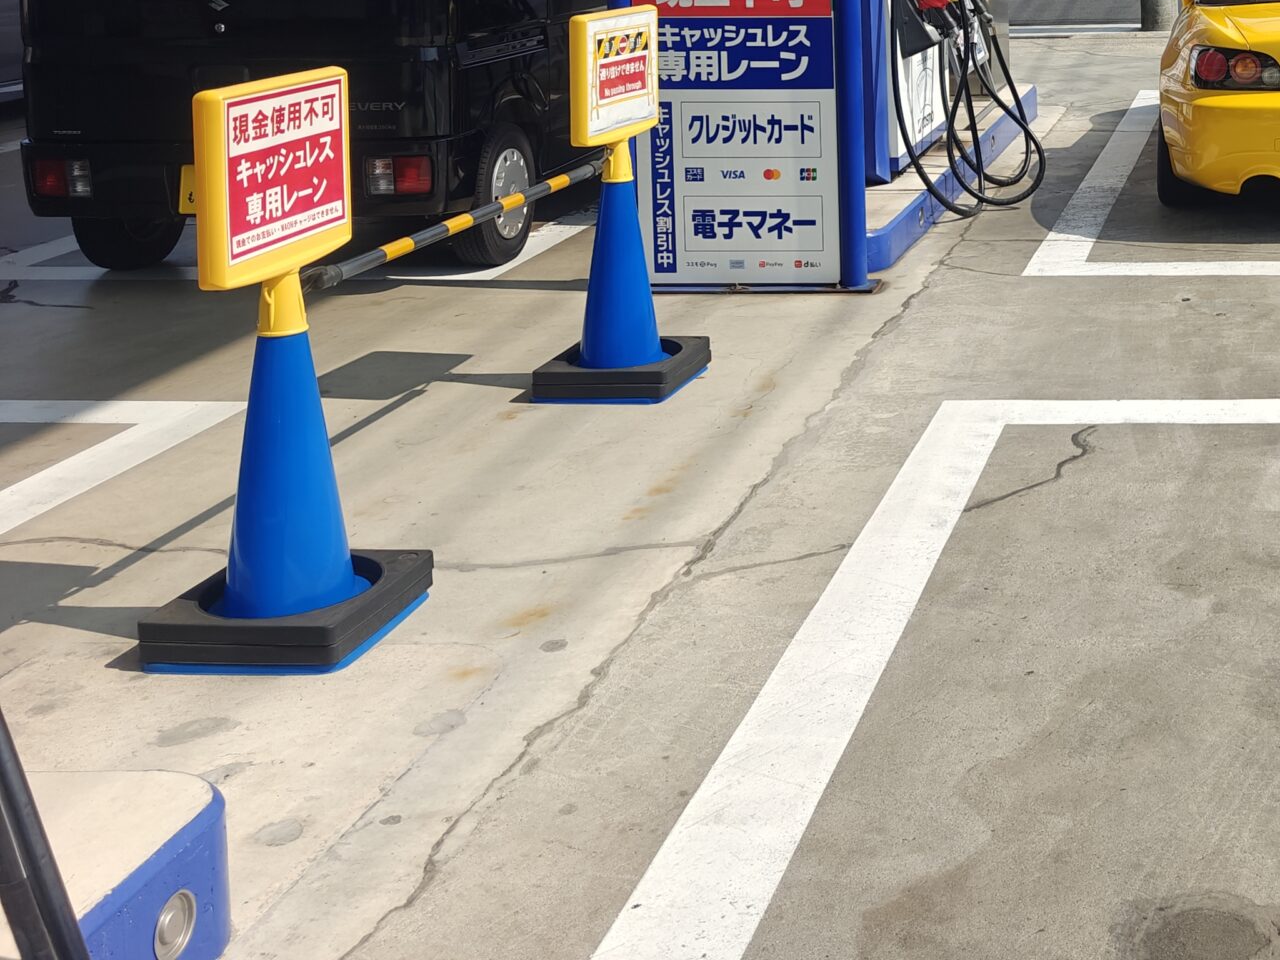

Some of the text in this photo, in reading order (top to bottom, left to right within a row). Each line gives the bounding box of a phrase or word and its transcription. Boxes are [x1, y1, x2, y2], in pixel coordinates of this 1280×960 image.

[658, 24, 811, 48] キャッシュレス
[658, 50, 809, 82] 専用レーン
[232, 93, 336, 145] 現金使用不可
[688, 114, 815, 145] クレジットカード
[236, 135, 335, 189] キャッシュレス
[720, 170, 746, 179] VISA
[245, 176, 328, 225] 専用レーン
[654, 106, 674, 268] キャッシュレス割引中
[692, 209, 817, 240] 電子マネー
